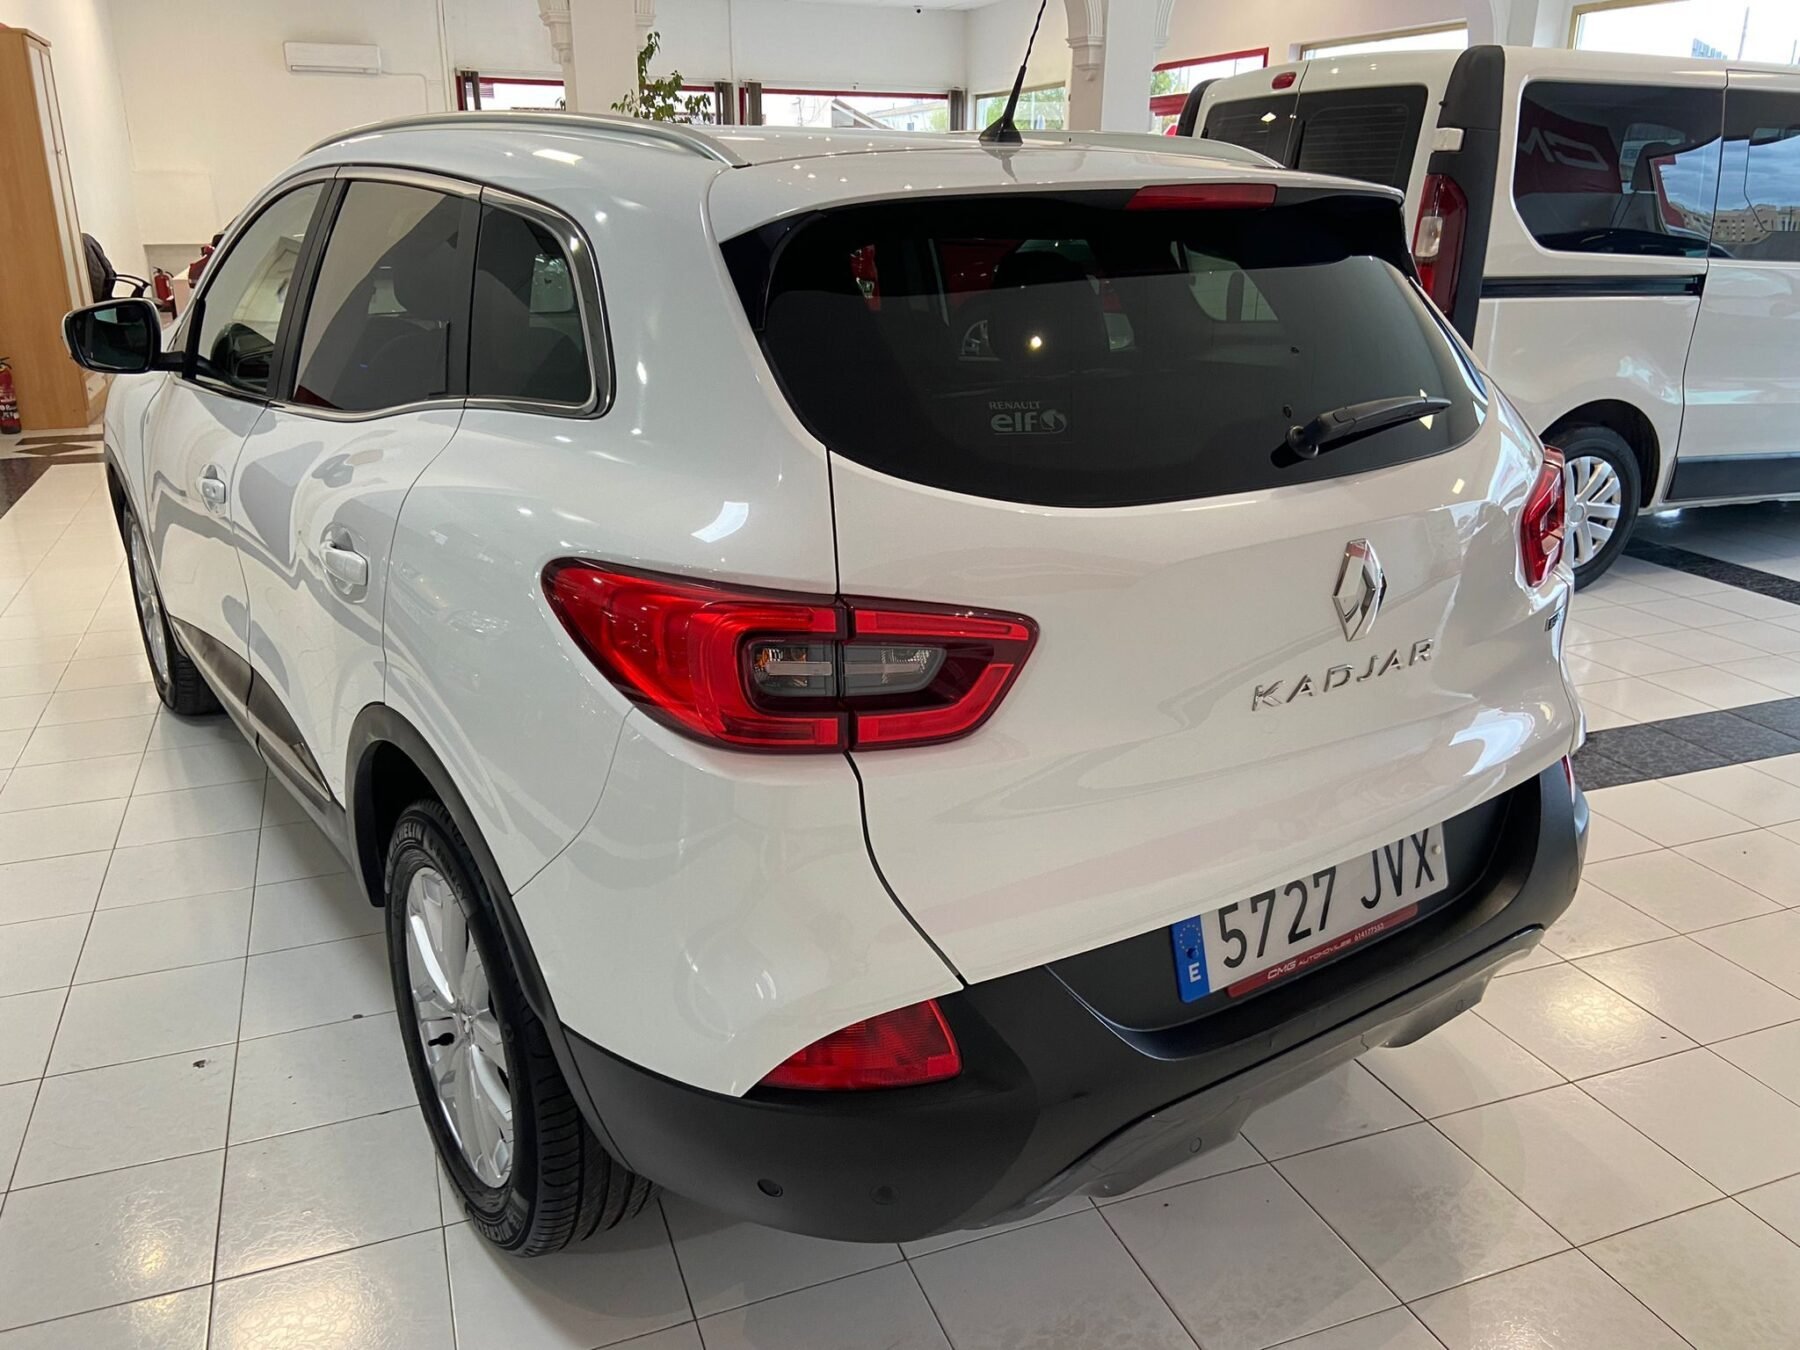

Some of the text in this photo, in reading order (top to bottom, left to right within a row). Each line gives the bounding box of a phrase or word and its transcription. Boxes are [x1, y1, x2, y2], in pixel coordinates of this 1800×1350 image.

[989, 401, 1040, 410] RENAULT
[990, 411, 1037, 432] elf
[1252, 638, 1434, 711] KADJAR
[1218, 828, 1434, 969] 5727 JVX
[1188, 962, 1202, 983] E
[1267, 960, 1297, 980] CMG
